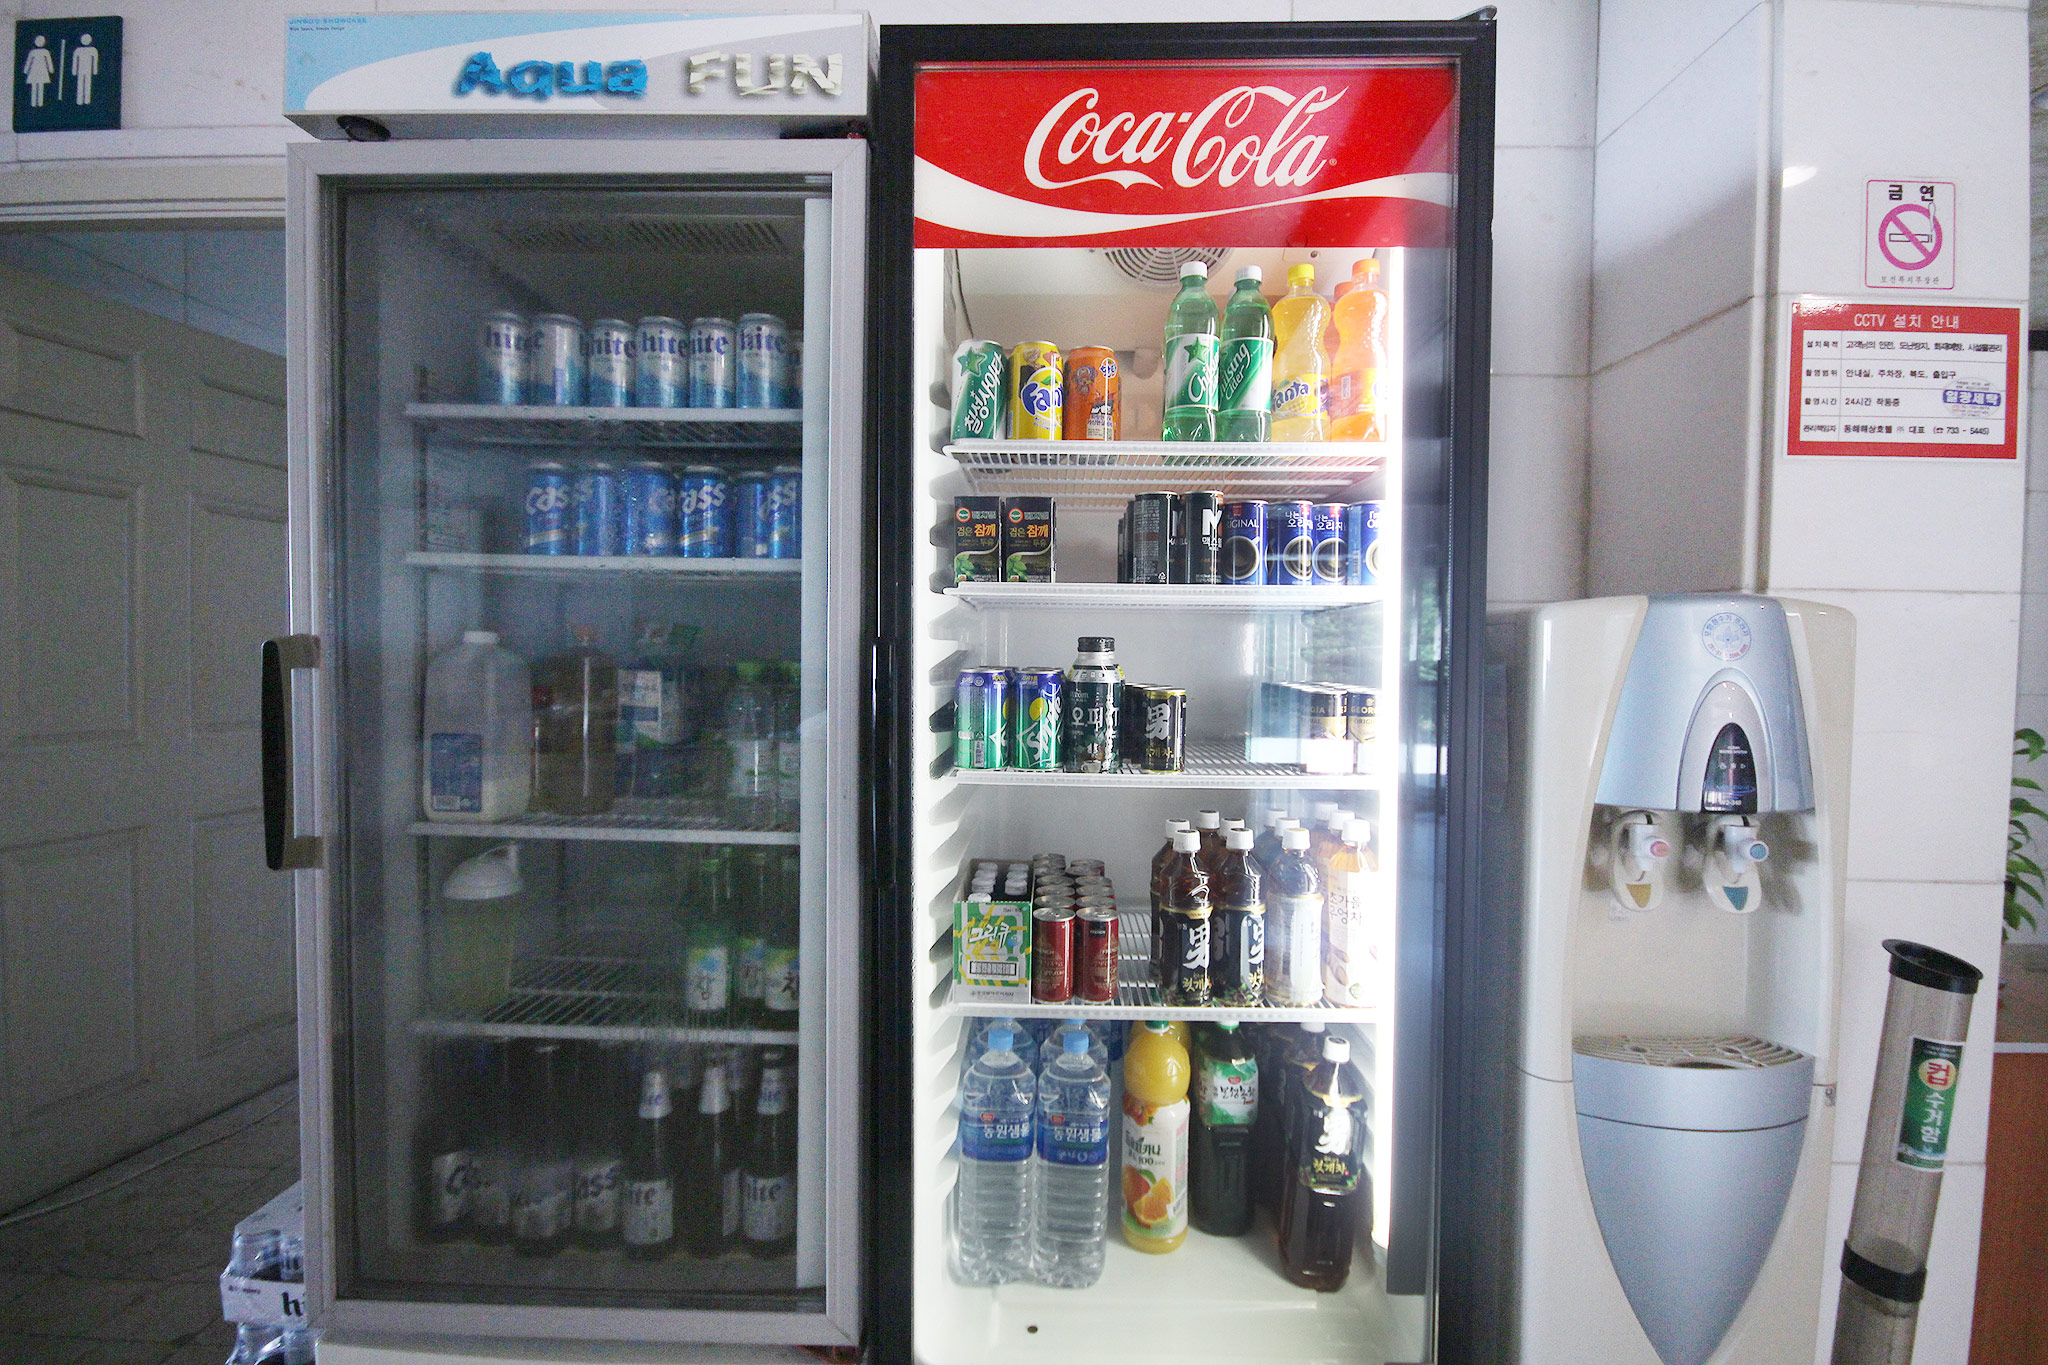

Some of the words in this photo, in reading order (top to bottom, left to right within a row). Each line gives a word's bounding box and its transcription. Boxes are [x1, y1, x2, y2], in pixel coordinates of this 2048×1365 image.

[459, 51, 649, 100] Aqua
[688, 50, 844, 96] FUN
[1024, 85, 1350, 190] Coca-Cola
[1854, 313, 1886, 327] CCTV
[1893, 314, 1922, 328] 설치
[1931, 315, 1960, 329] 안내
[1844, 397, 1872, 406] 24시간
[957, 526, 973, 537] 검은
[974, 523, 997, 538] 참깨
[1009, 527, 1026, 538] 검은
[1026, 524, 1050, 538] 참깨
[1920, 1090, 1946, 1144] 수거함
[983, 1121, 1031, 1140] 동원샘물
[1053, 1125, 1102, 1144] 동원샘물
